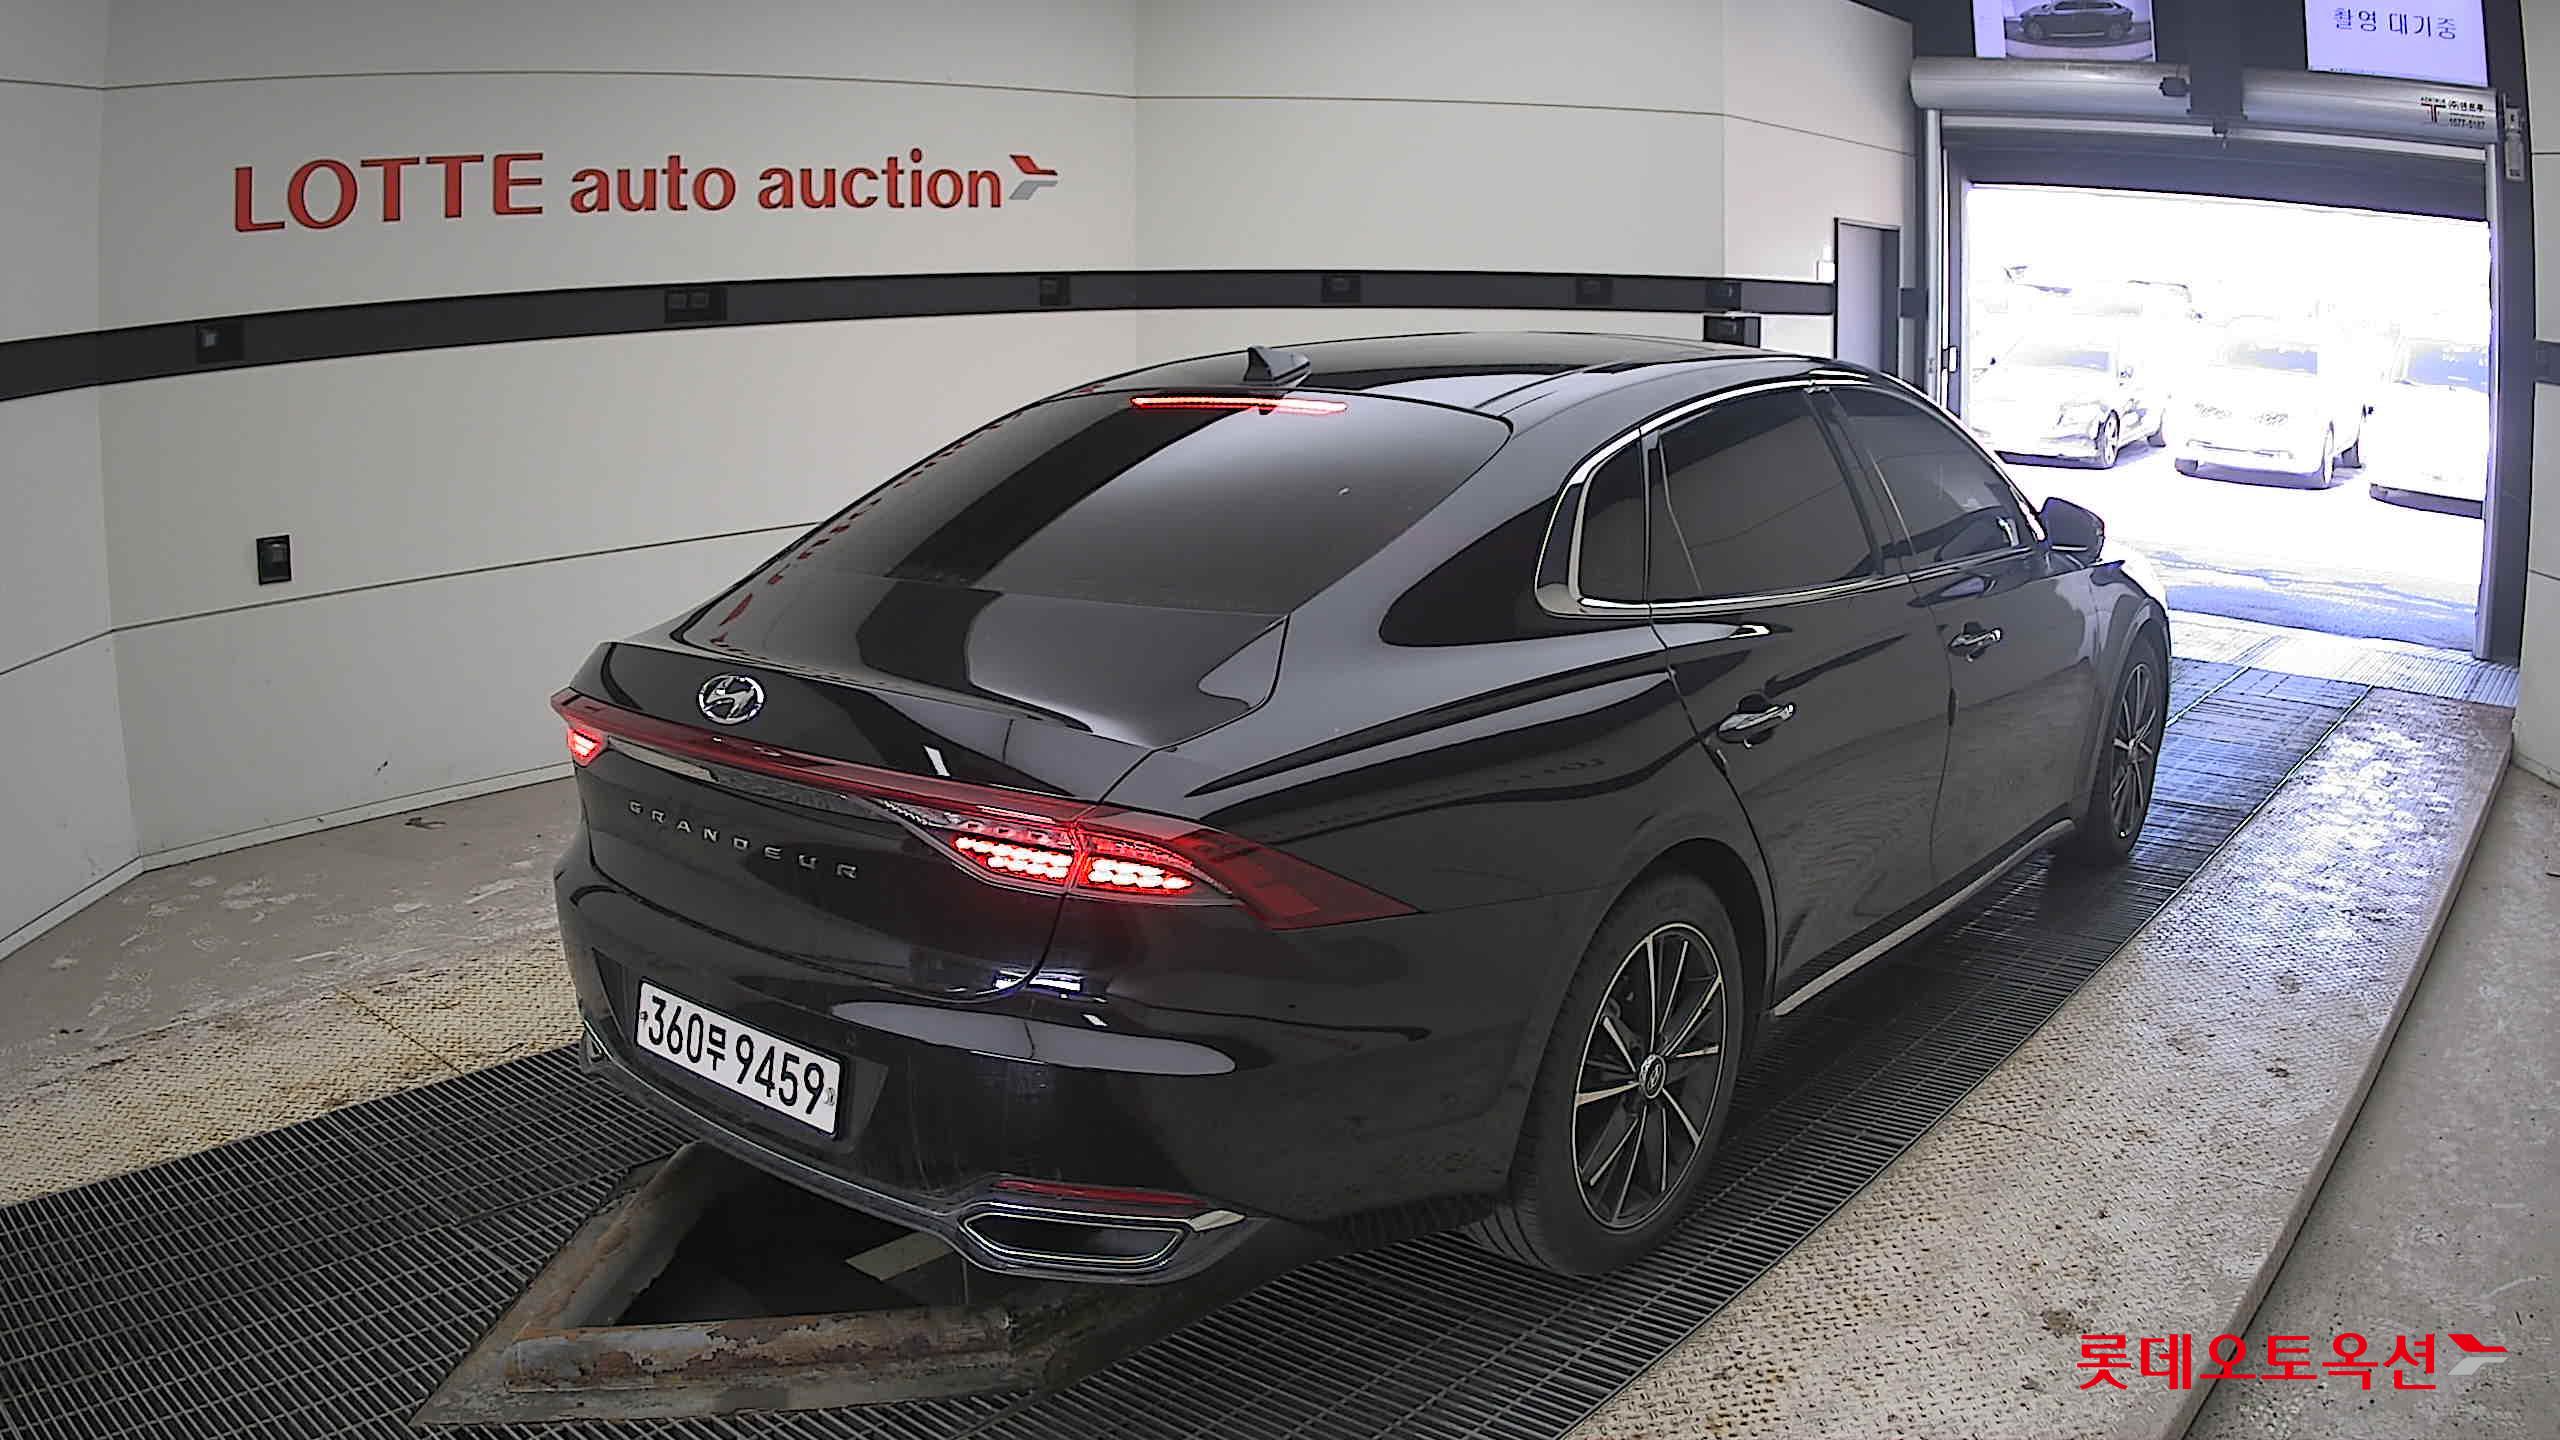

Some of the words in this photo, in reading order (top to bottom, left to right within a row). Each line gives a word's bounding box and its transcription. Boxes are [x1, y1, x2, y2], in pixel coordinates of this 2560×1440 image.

[2388, 13, 2457, 40] 대기중
[234, 151, 544, 232] LOTTE
[569, 153, 737, 214] auto
[757, 147, 1003, 209] auction
[629, 799, 858, 880] GRANDEUR
[648, 994, 728, 1072] 360무
[734, 1033, 825, 1115] 9459
